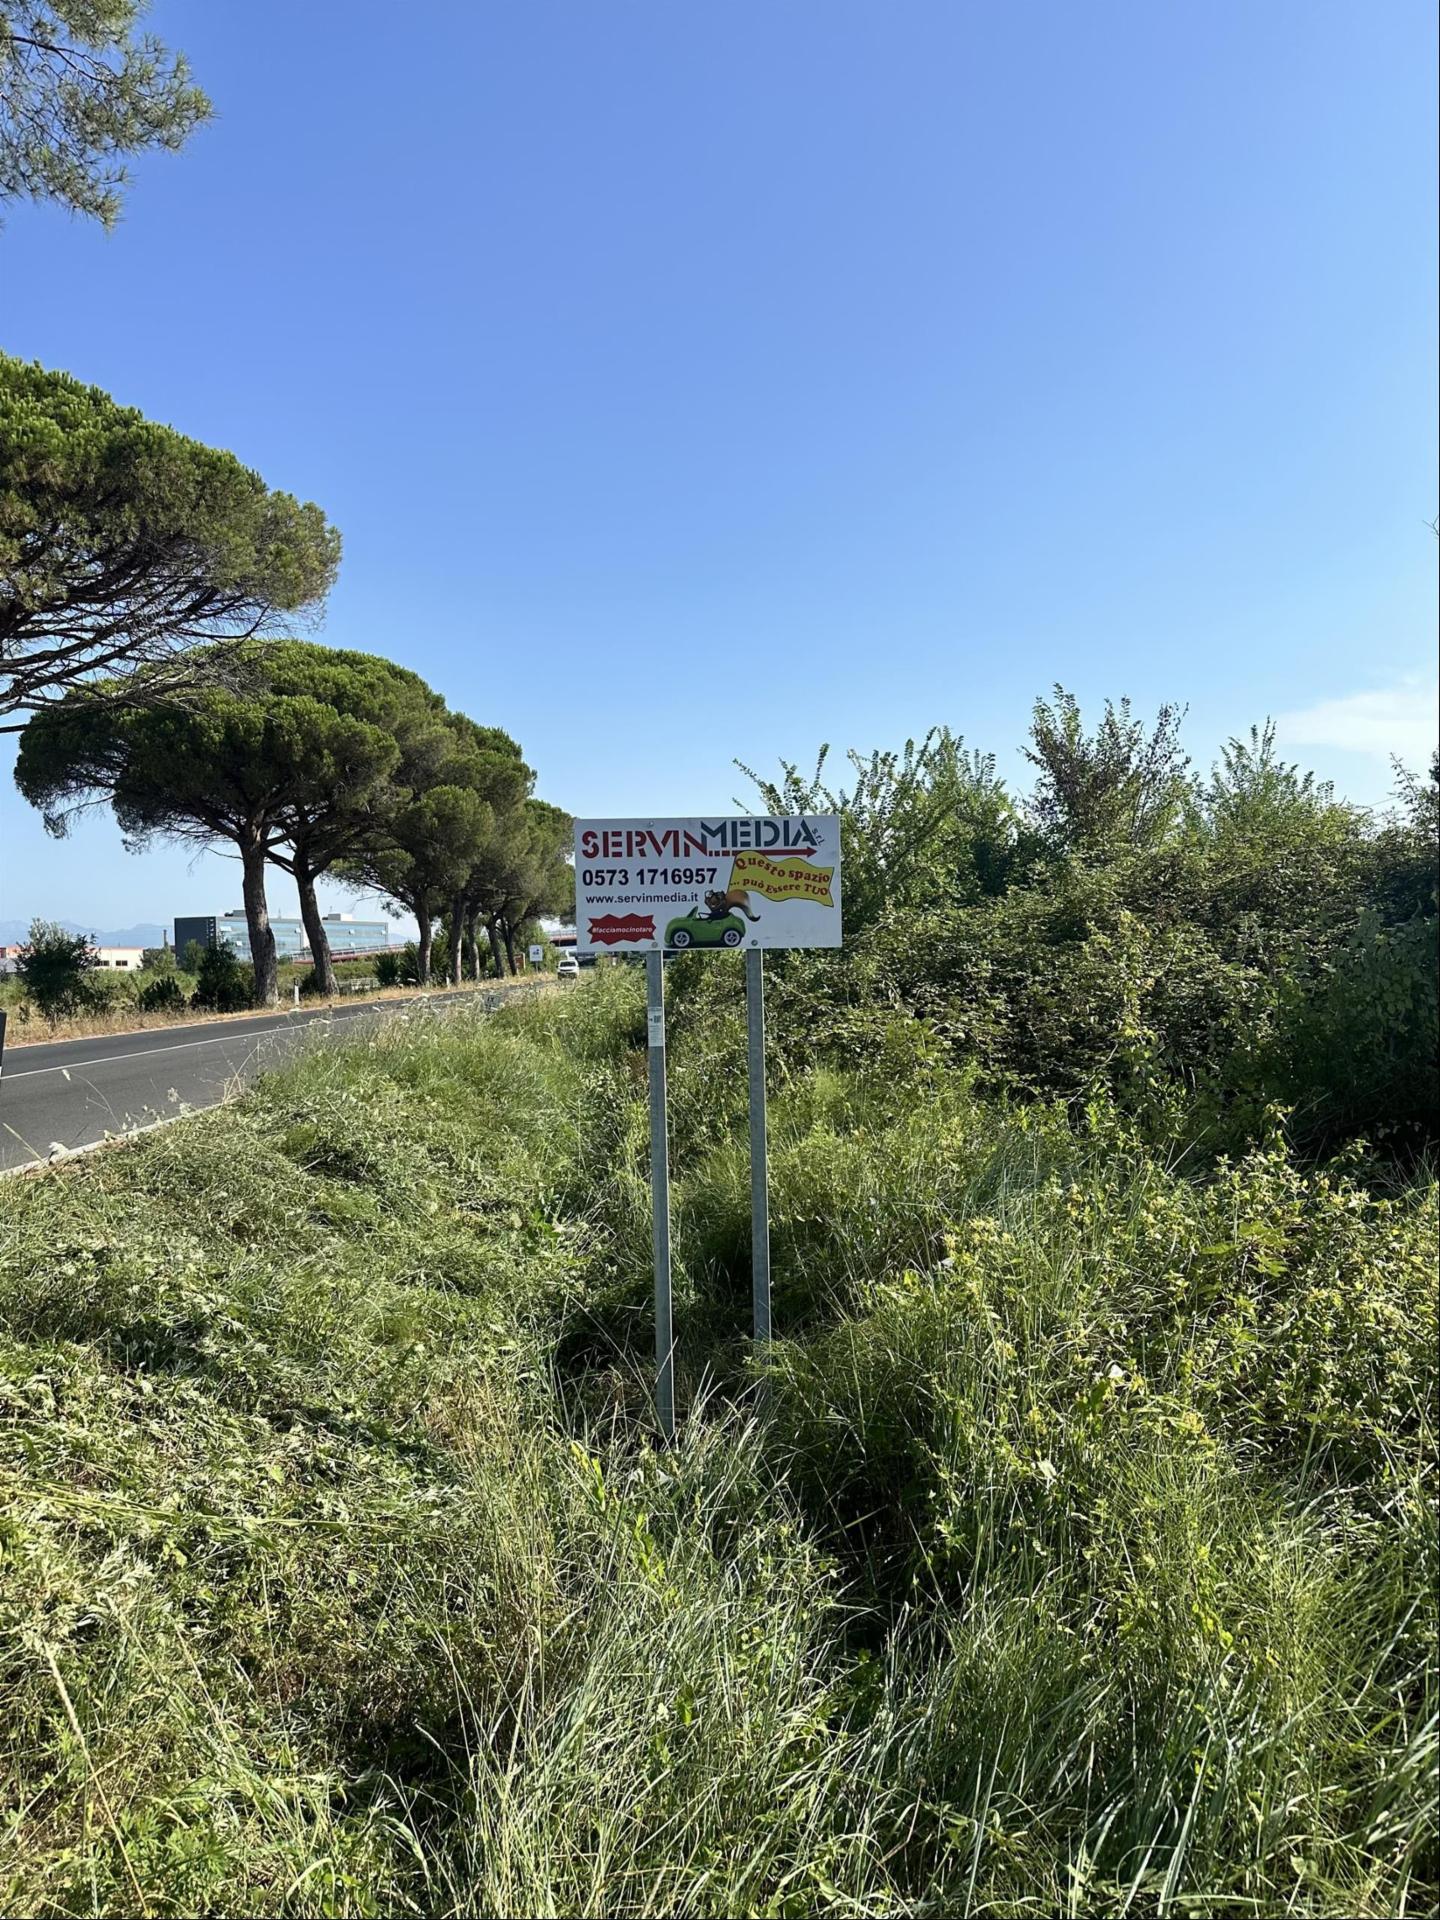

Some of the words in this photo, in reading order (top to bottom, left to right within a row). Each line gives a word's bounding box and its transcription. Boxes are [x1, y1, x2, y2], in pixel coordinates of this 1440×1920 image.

[582, 869, 629, 886] 0573
[636, 868, 718, 885] 1716957
[735, 857, 786, 877] Questo
[788, 869, 830, 883] spazio
[803, 883, 829, 896] TUO
[585, 892, 699, 904] www.servinmedia.it
